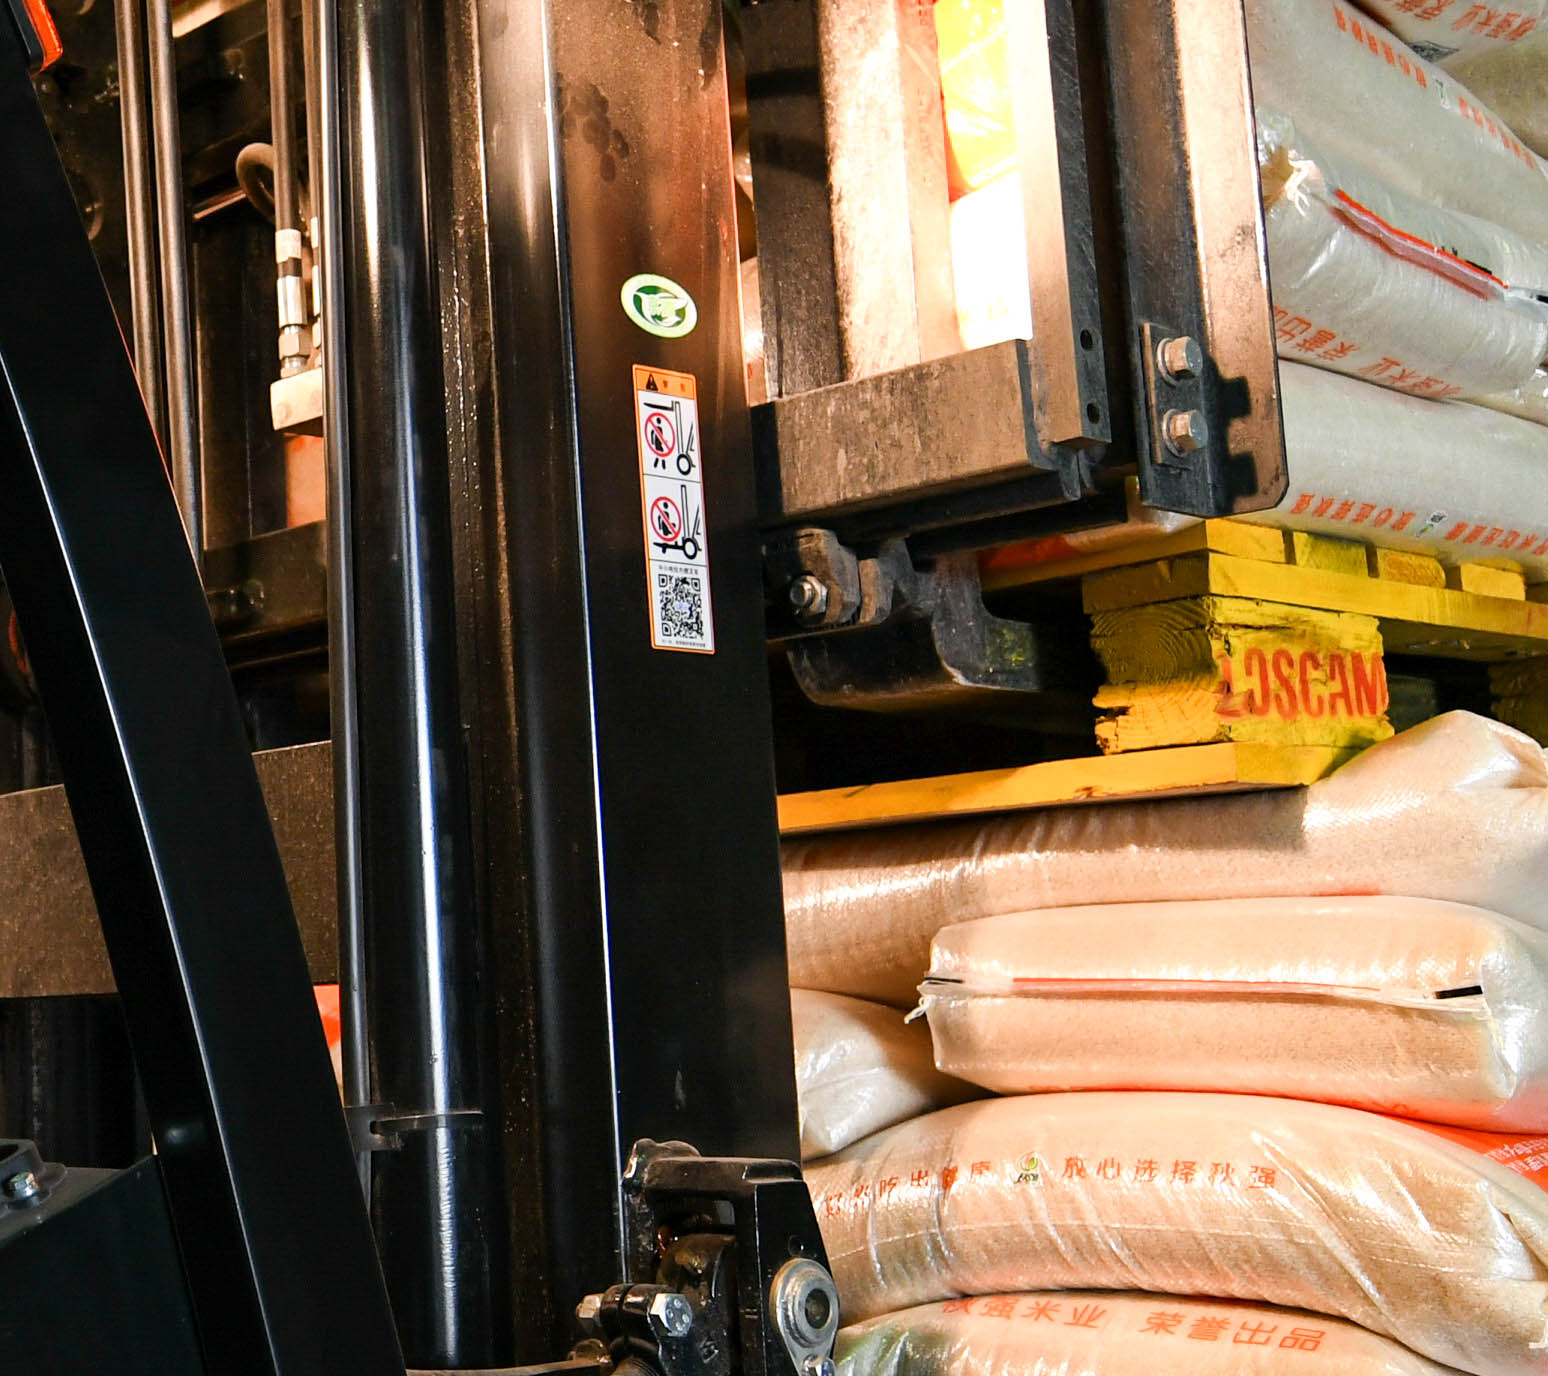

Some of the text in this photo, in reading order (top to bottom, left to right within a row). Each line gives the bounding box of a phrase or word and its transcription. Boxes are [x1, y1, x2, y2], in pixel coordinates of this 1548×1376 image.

[1215, 645, 1389, 721] LOSCAM
[1061, 1156, 1278, 1190] 放心选择秋强
[943, 1295, 1327, 1353] 秋强米业 荣誉出品
